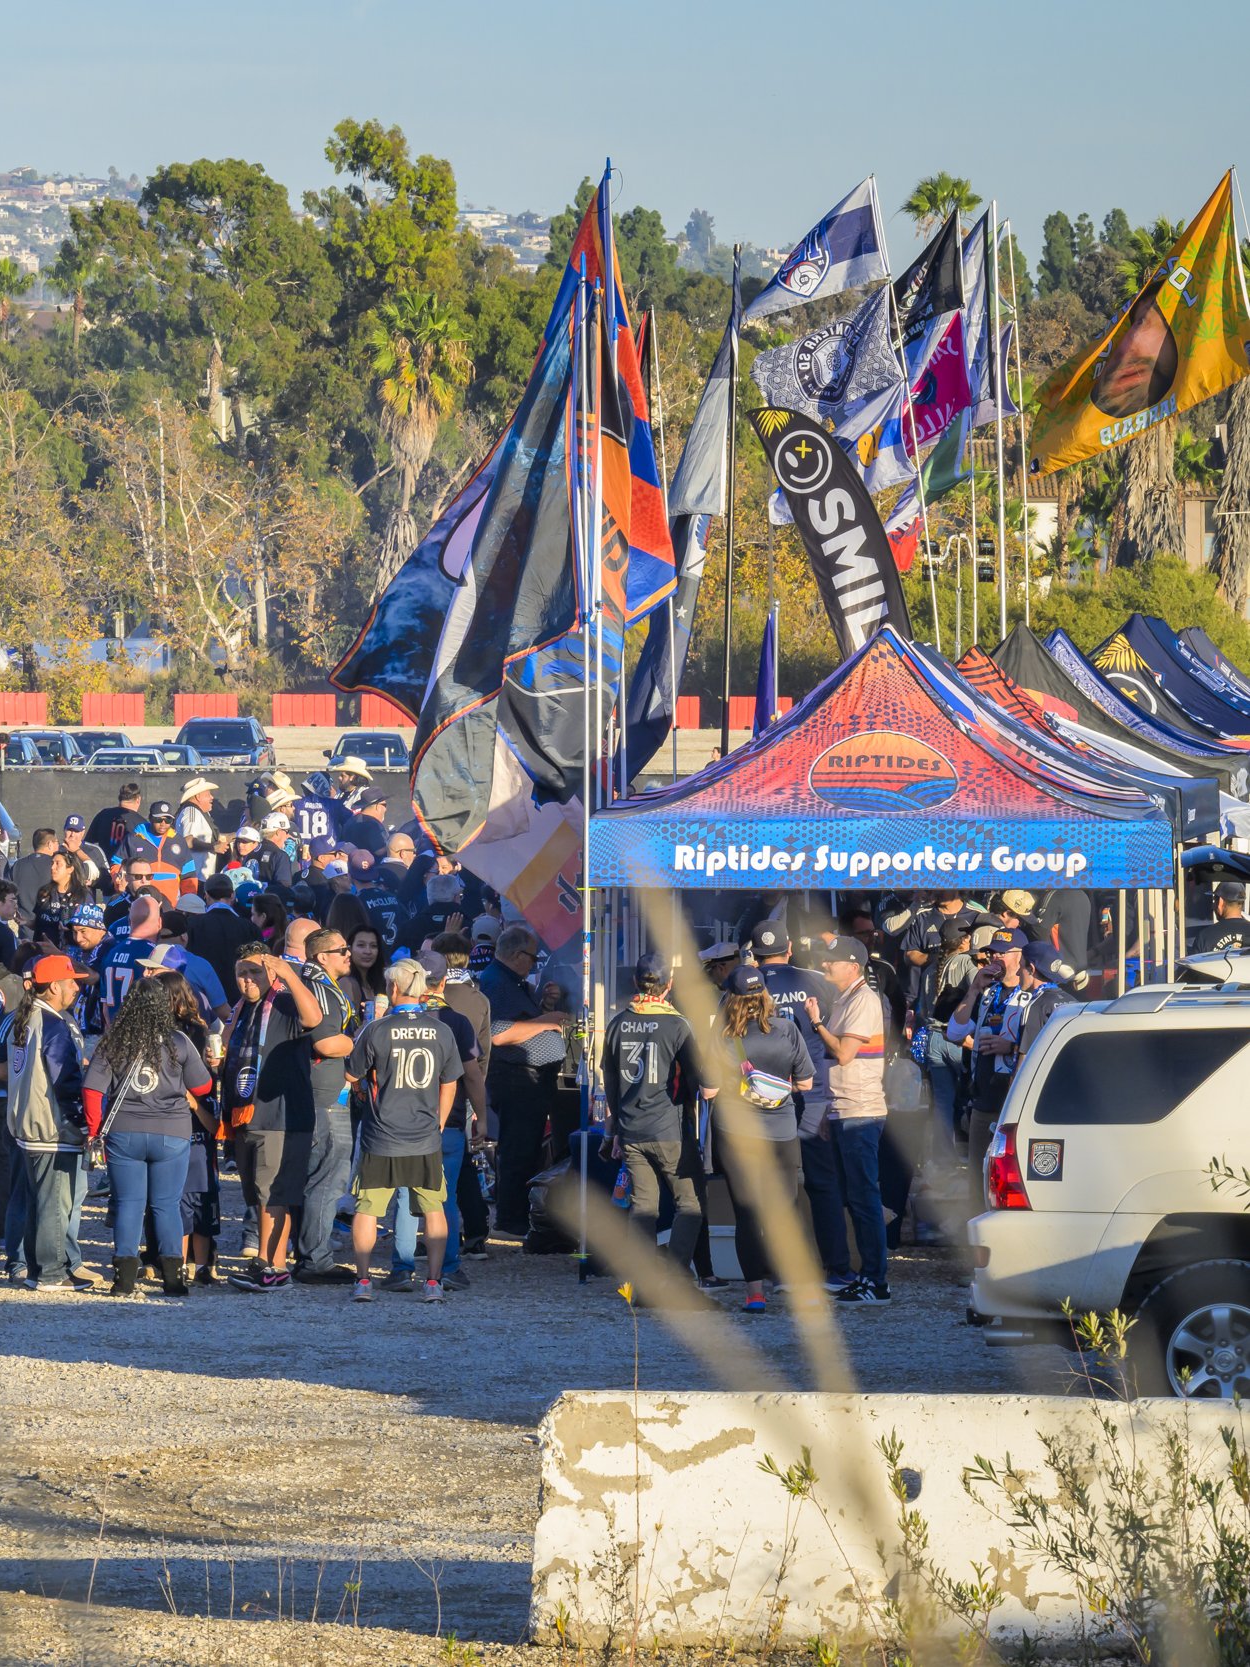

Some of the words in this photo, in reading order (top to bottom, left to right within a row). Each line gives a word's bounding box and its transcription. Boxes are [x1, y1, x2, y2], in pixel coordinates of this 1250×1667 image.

[827, 754, 942, 774] RIPTIDES
[69, 816, 79, 825] SD
[109, 821, 126, 846] 10
[299, 810, 328, 839] 18
[674, 844, 806, 877] Riptides
[814, 843, 983, 878] Supporters
[991, 845, 1088, 878] Group
[381, 911, 398, 946] 3
[1216, 932, 1234, 949] STAY
[101, 966, 134, 1005] 17
[772, 990, 805, 1005] ZANO
[390, 1027, 437, 1041] DREYER
[620, 1021, 659, 1033] CHAMP
[392, 1047, 435, 1090] 10
[620, 1041, 658, 1085] 31
[130, 1065, 160, 1095] 6
